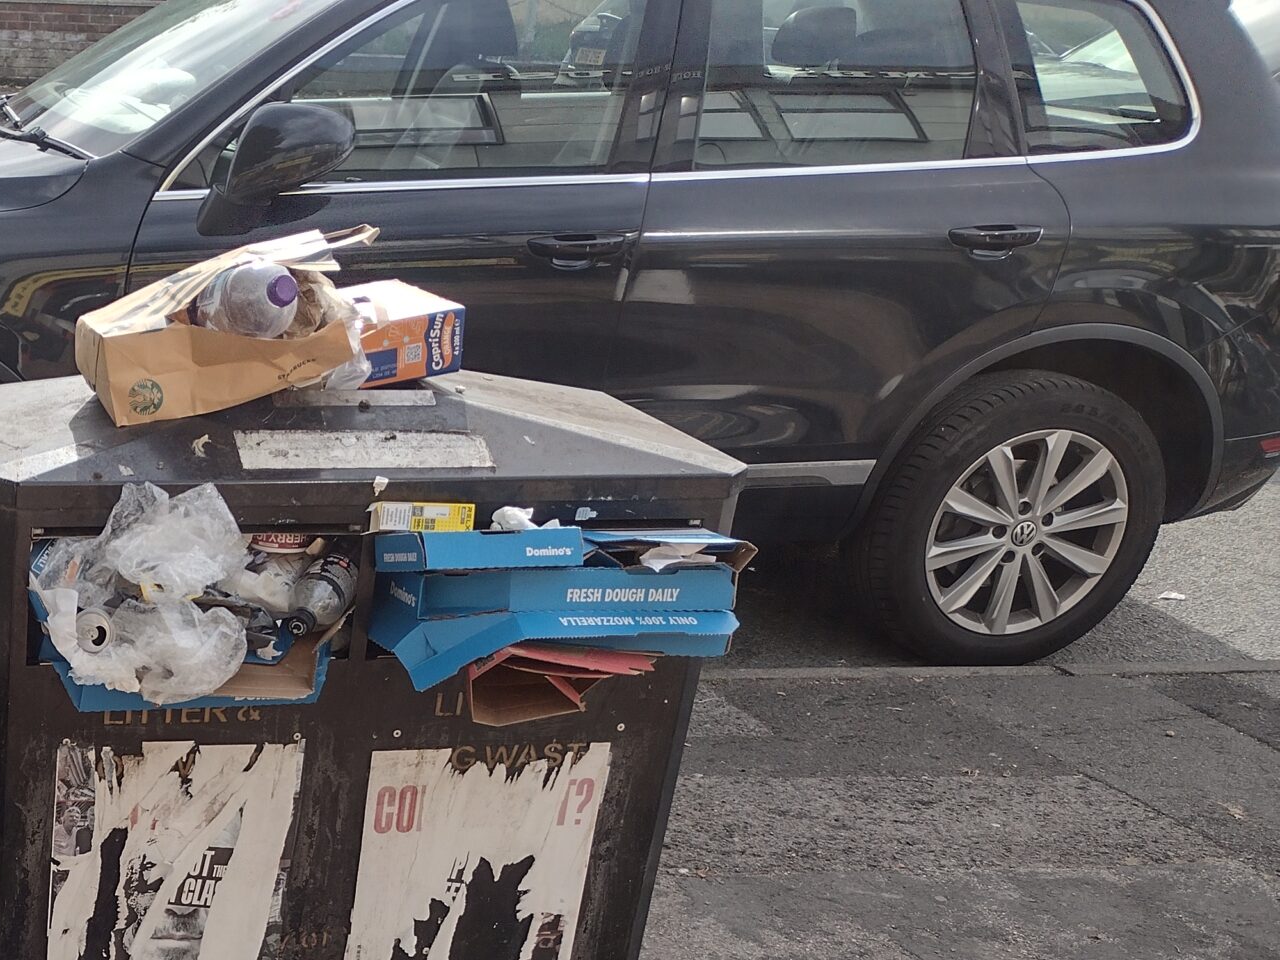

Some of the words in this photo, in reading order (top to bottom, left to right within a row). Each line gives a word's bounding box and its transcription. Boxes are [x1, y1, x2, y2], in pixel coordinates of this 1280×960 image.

[442, 326, 451, 355] ORANGE
[269, 533, 307, 543] HERRY
[526, 546, 572, 557] Domino's
[389, 580, 416, 607] Domino's
[567, 588, 602, 603] FRESH
[604, 588, 645, 602] DOUGH
[648, 588, 680, 602] DAILY
[559, 616, 634, 626] MOZZARELLA
[636, 616, 666, 626] 100%
[670, 616, 698, 626] ONLY
[434, 692, 464, 717] LI
[103, 706, 228, 725] LITTER
[485, 742, 588, 769] WAST
[373, 784, 427, 834] CO
[180, 878, 216, 906] CLA
